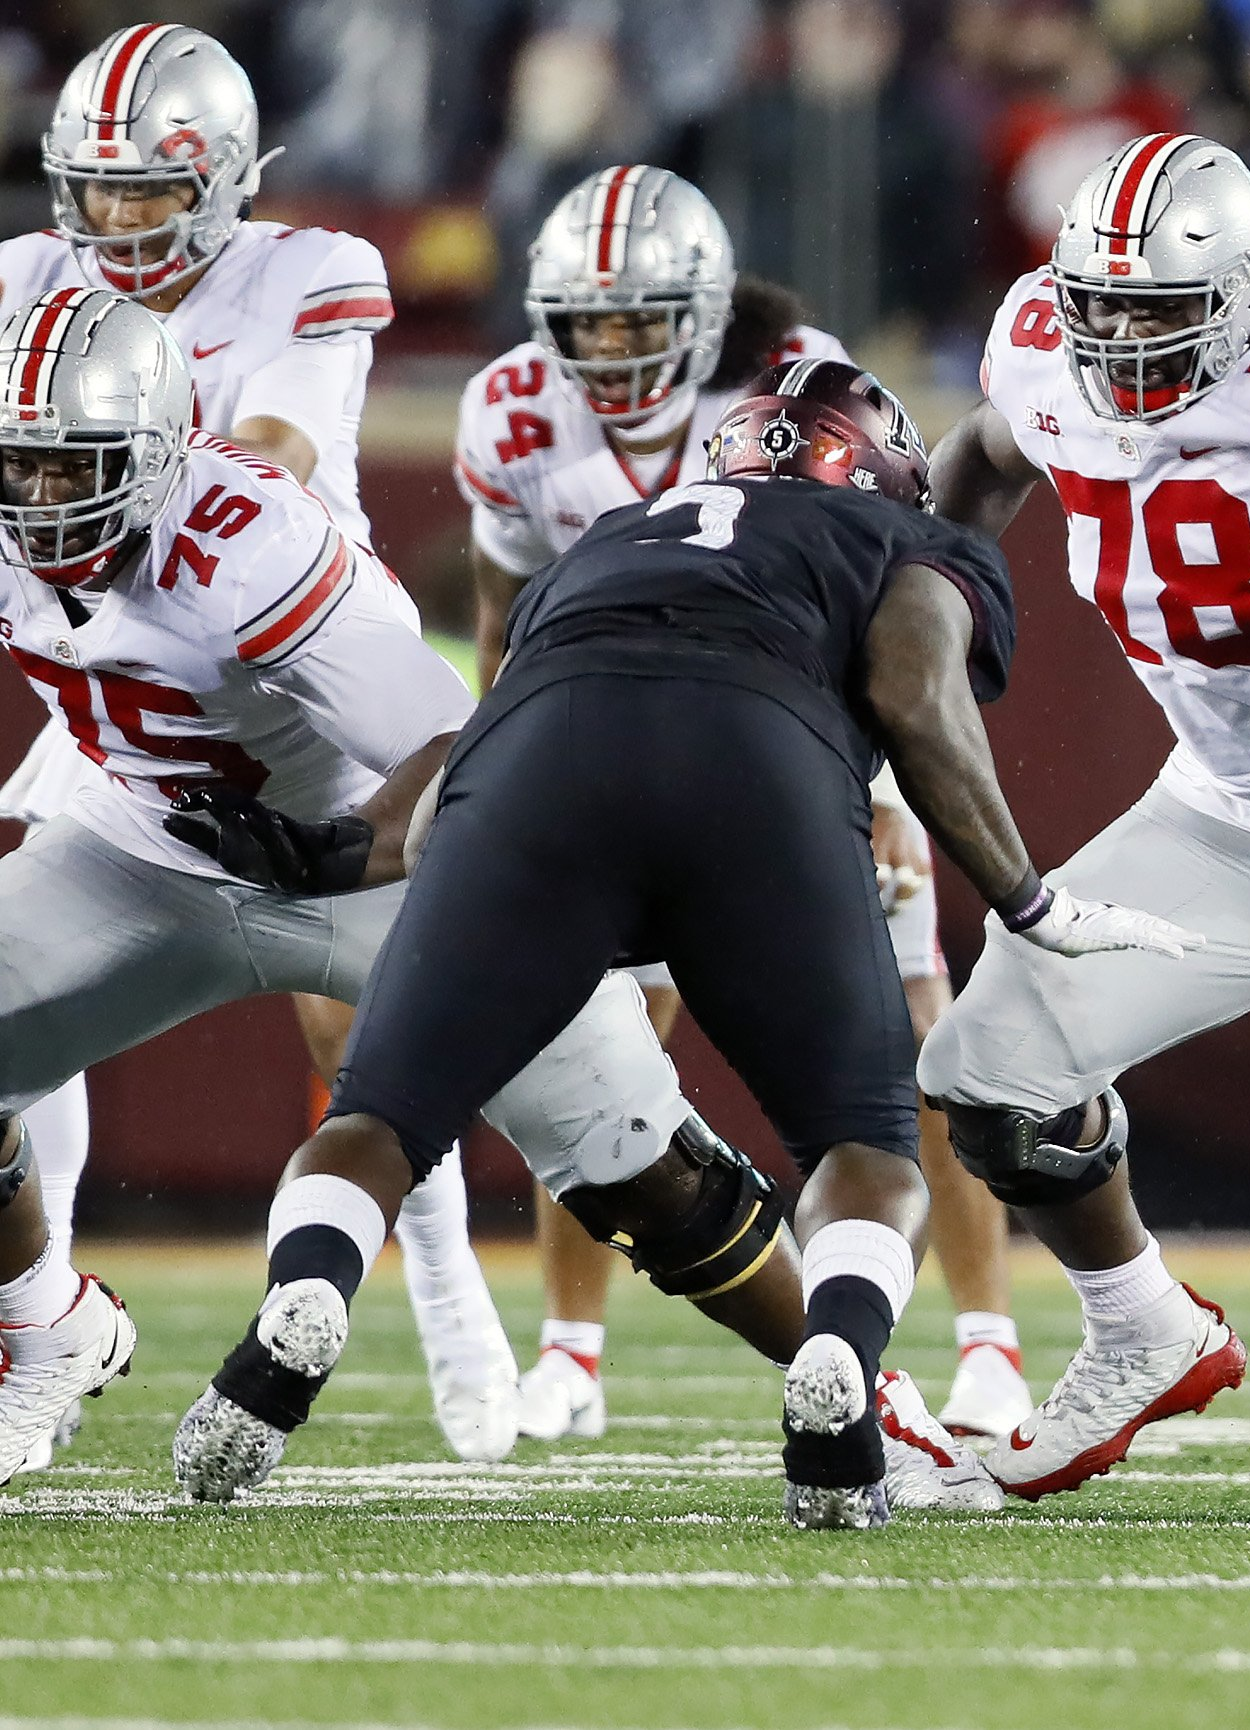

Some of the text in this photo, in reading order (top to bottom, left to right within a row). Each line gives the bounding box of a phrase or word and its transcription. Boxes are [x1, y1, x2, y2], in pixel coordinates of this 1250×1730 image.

[1010, 278, 1062, 351] 8
[485, 359, 556, 465] 24
[771, 430, 784, 448] 5
[156, 484, 263, 592] 75
[8, 644, 272, 802] 75
